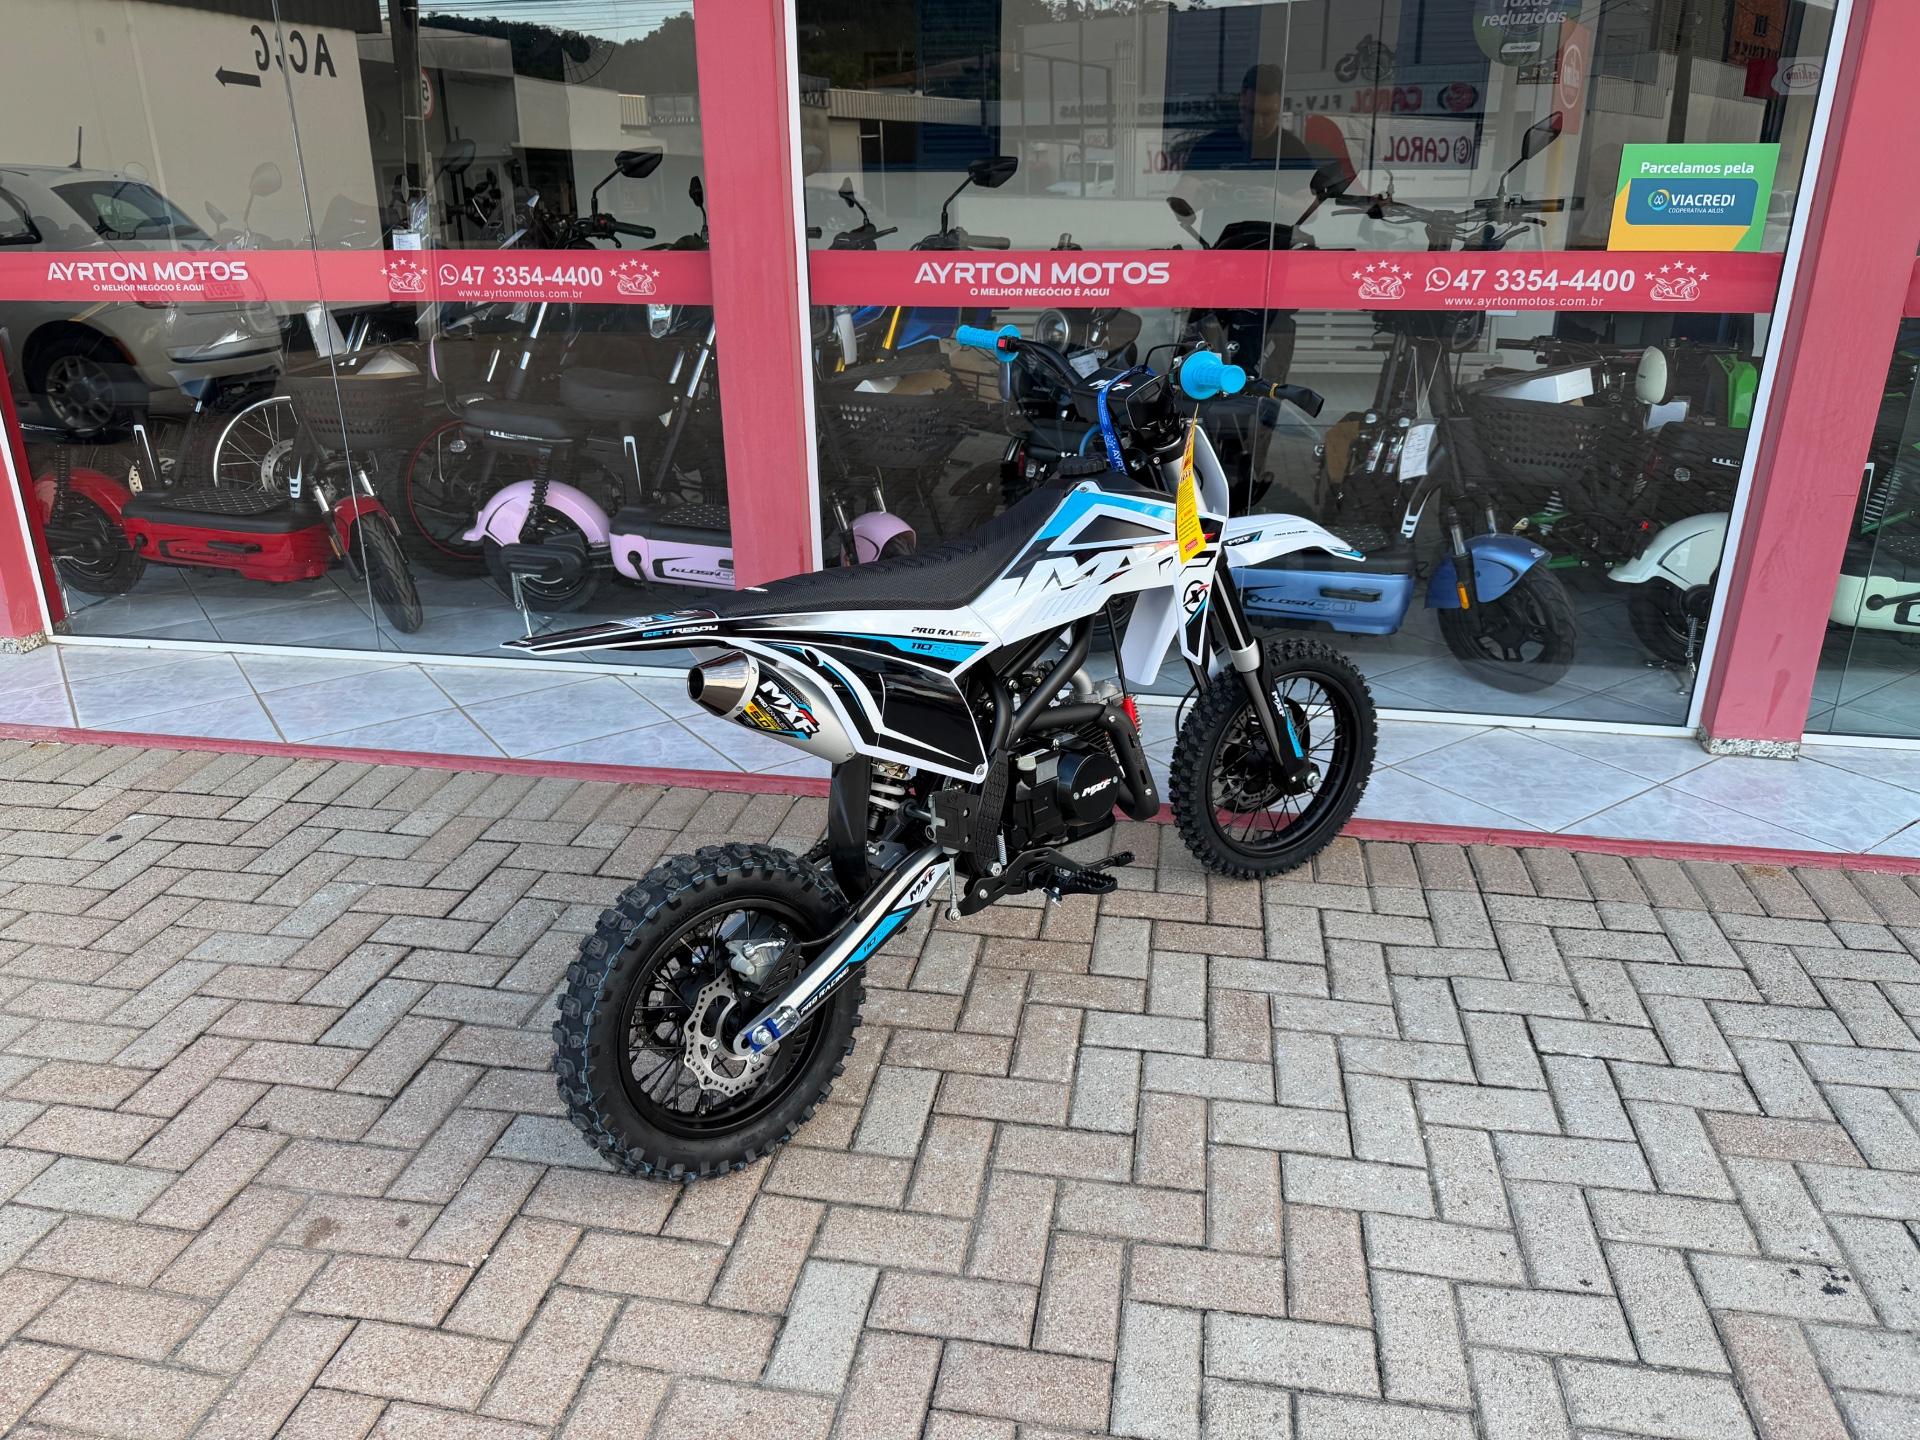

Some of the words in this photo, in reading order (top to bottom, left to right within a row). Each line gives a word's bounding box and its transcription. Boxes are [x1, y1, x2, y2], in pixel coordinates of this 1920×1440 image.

[1481, 8, 1568, 27] reduzidas
[1640, 162, 1721, 174] Parcelamos
[1723, 162, 1755, 176] pela
[1670, 194, 1735, 206] VIACREDI
[48, 261, 147, 281] AYRTON
[153, 261, 249, 281] MOTOS
[461, 266, 485, 285] 47
[493, 266, 603, 286] 3354-4400
[914, 262, 1040, 285] AYRTON
[1051, 262, 1170, 285] MOTOS
[1453, 269, 1486, 291] 47
[1494, 269, 1635, 292] 3354-4400
[93, 284, 100, 292] O
[102, 283, 135, 292] MELHOR
[137, 282, 174, 292] NEGÓCIO
[176, 282, 181, 291] É
[183, 283, 204, 292] AQUI
[458, 289, 583, 299] www.ayrtonmotos.com.br
[970, 288, 978, 296] O
[980, 288, 1023, 296] MELHOR
[1024, 286, 1072, 297] NEGÓCIO
[1074, 286, 1081, 296] É
[1082, 288, 1110, 297] AQUI
[1444, 296, 1604, 307] www.ayrtonmotos.com.br
[911, 626, 936, 635] PRO
[937, 628, 982, 638] RACING
[759, 680, 820, 733] MXF
[1081, 778, 1111, 797] MXF
[910, 866, 936, 902] MXF
[800, 995, 818, 1015] PRO
[818, 967, 850, 998] RACING
